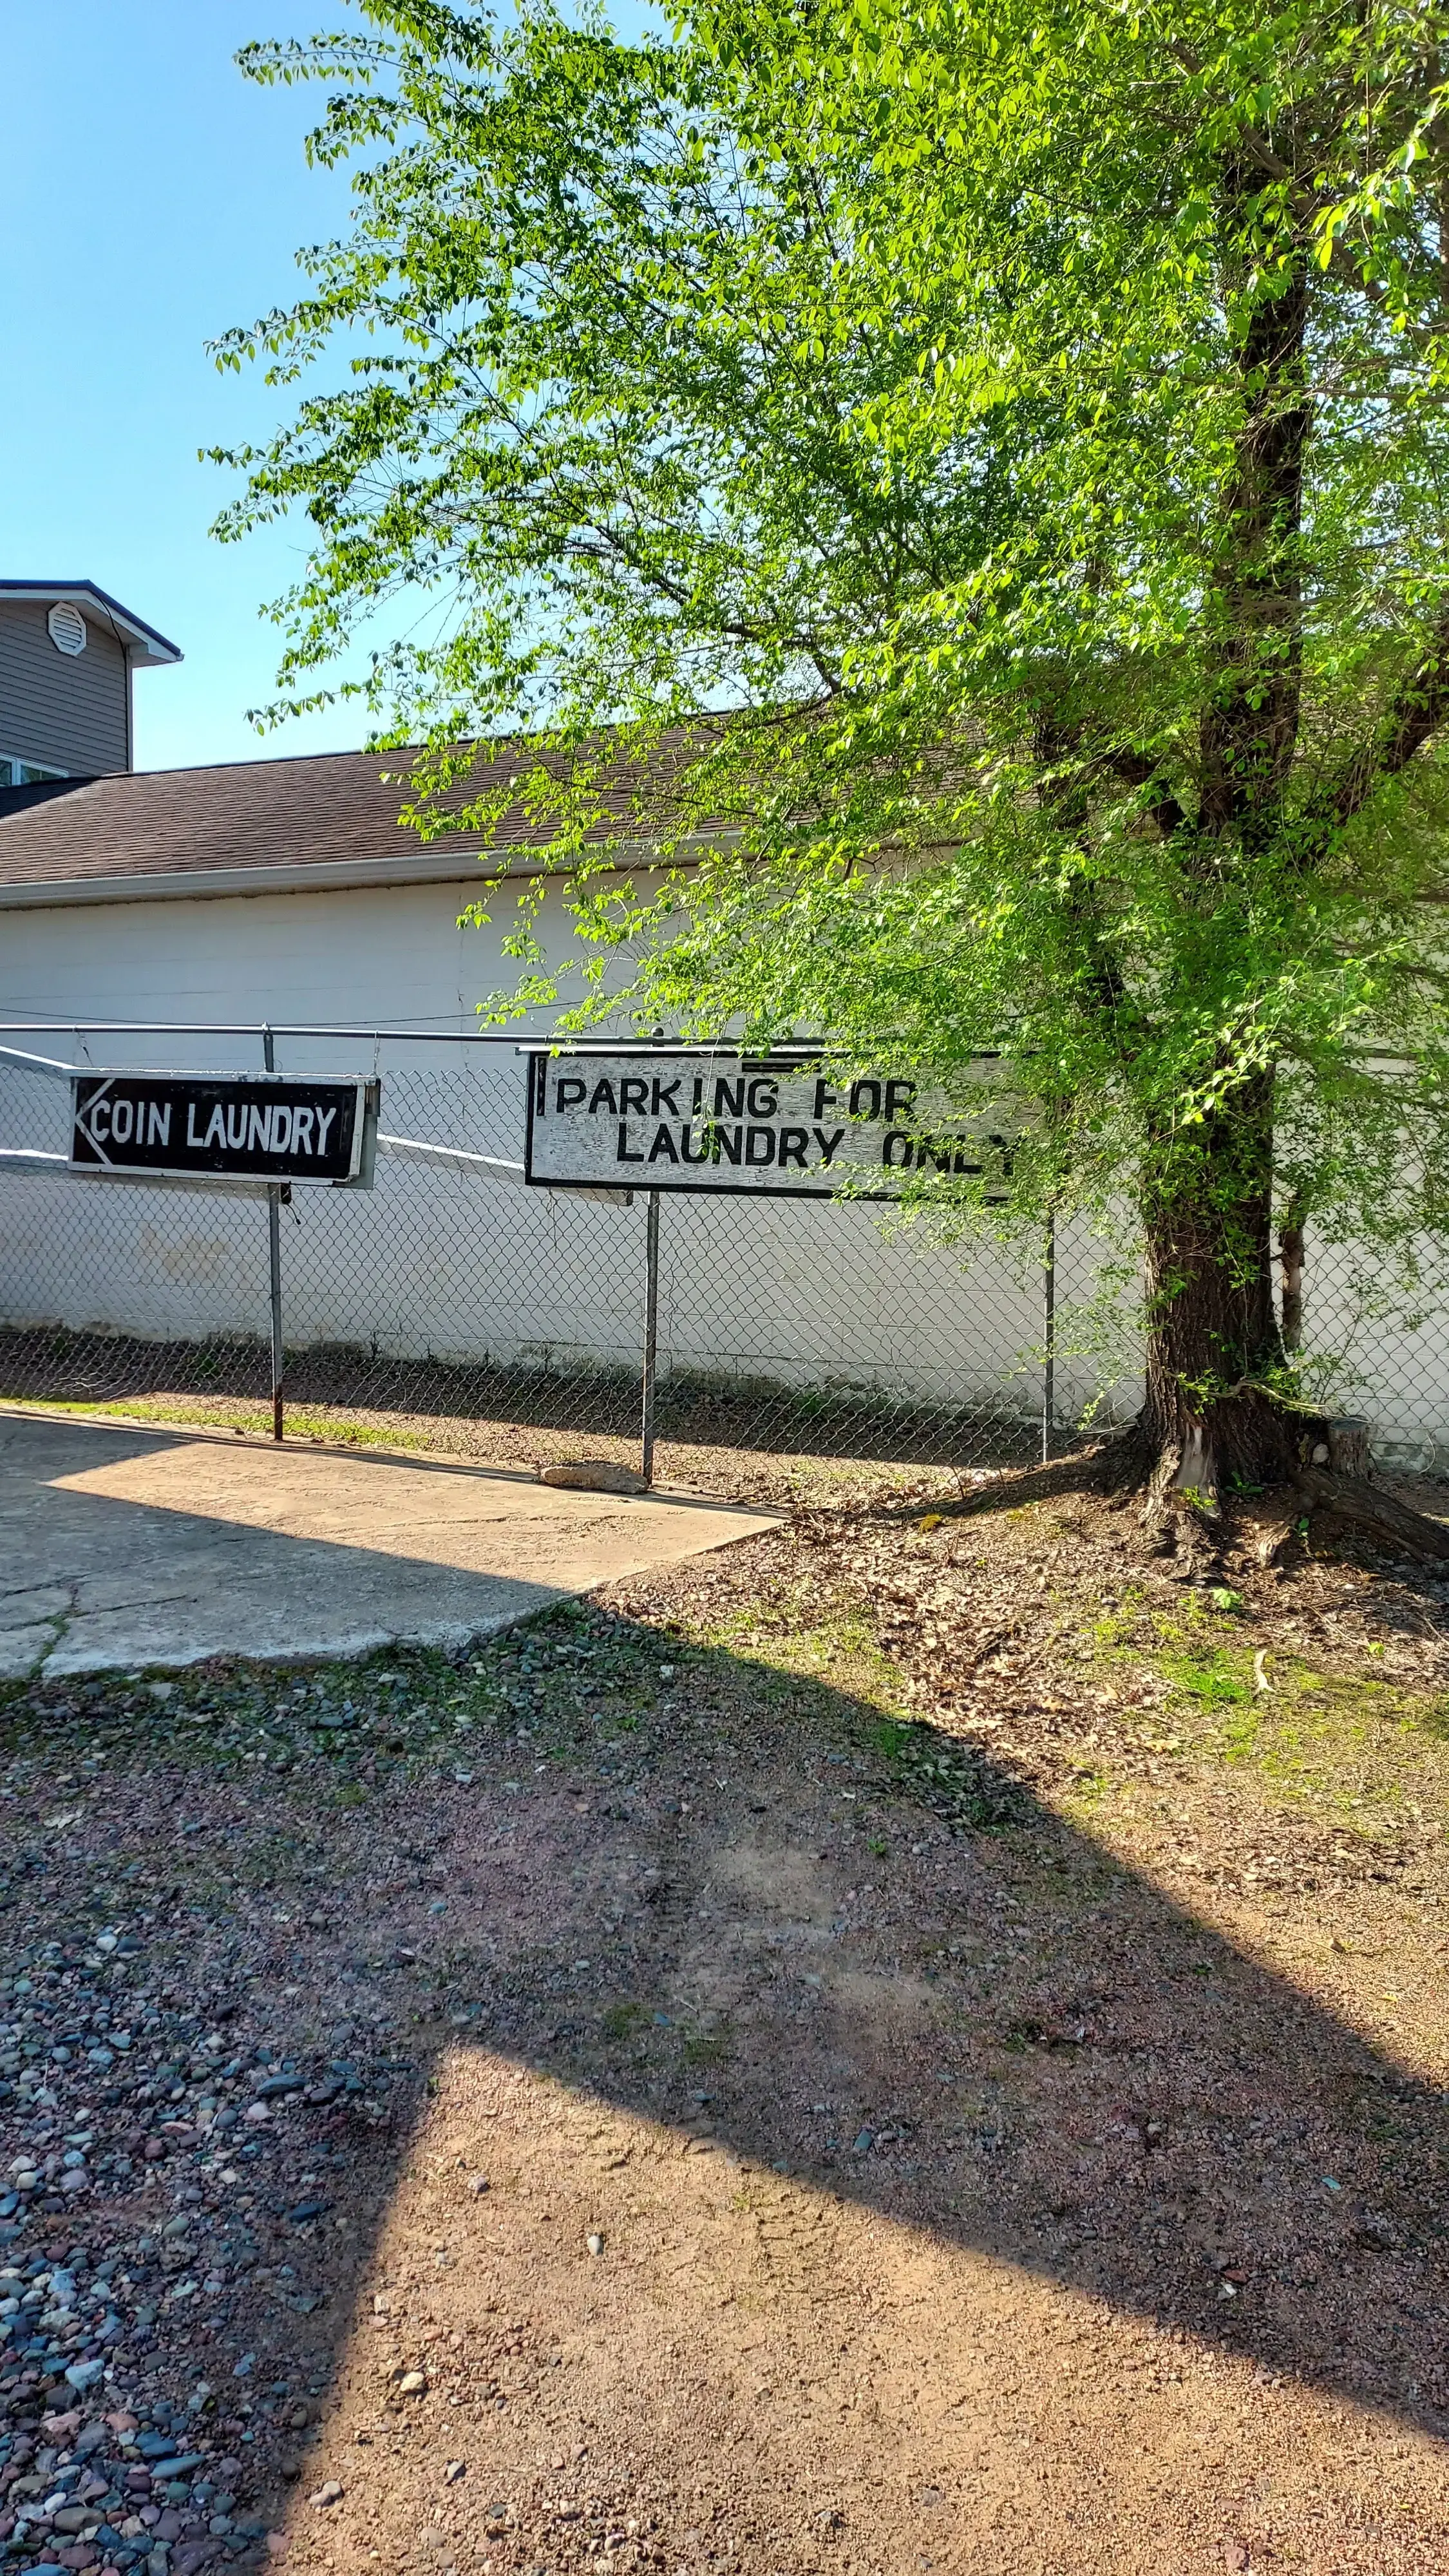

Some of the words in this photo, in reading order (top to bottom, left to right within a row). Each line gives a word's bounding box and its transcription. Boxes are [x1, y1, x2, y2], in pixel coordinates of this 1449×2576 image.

[556, 1077, 779, 1119] PARKING
[813, 1079, 918, 1123] FOR
[91, 1100, 171, 1146] COIN
[186, 1103, 337, 1156] LAUNDRY
[616, 1122, 846, 1168] LAUNDRY
